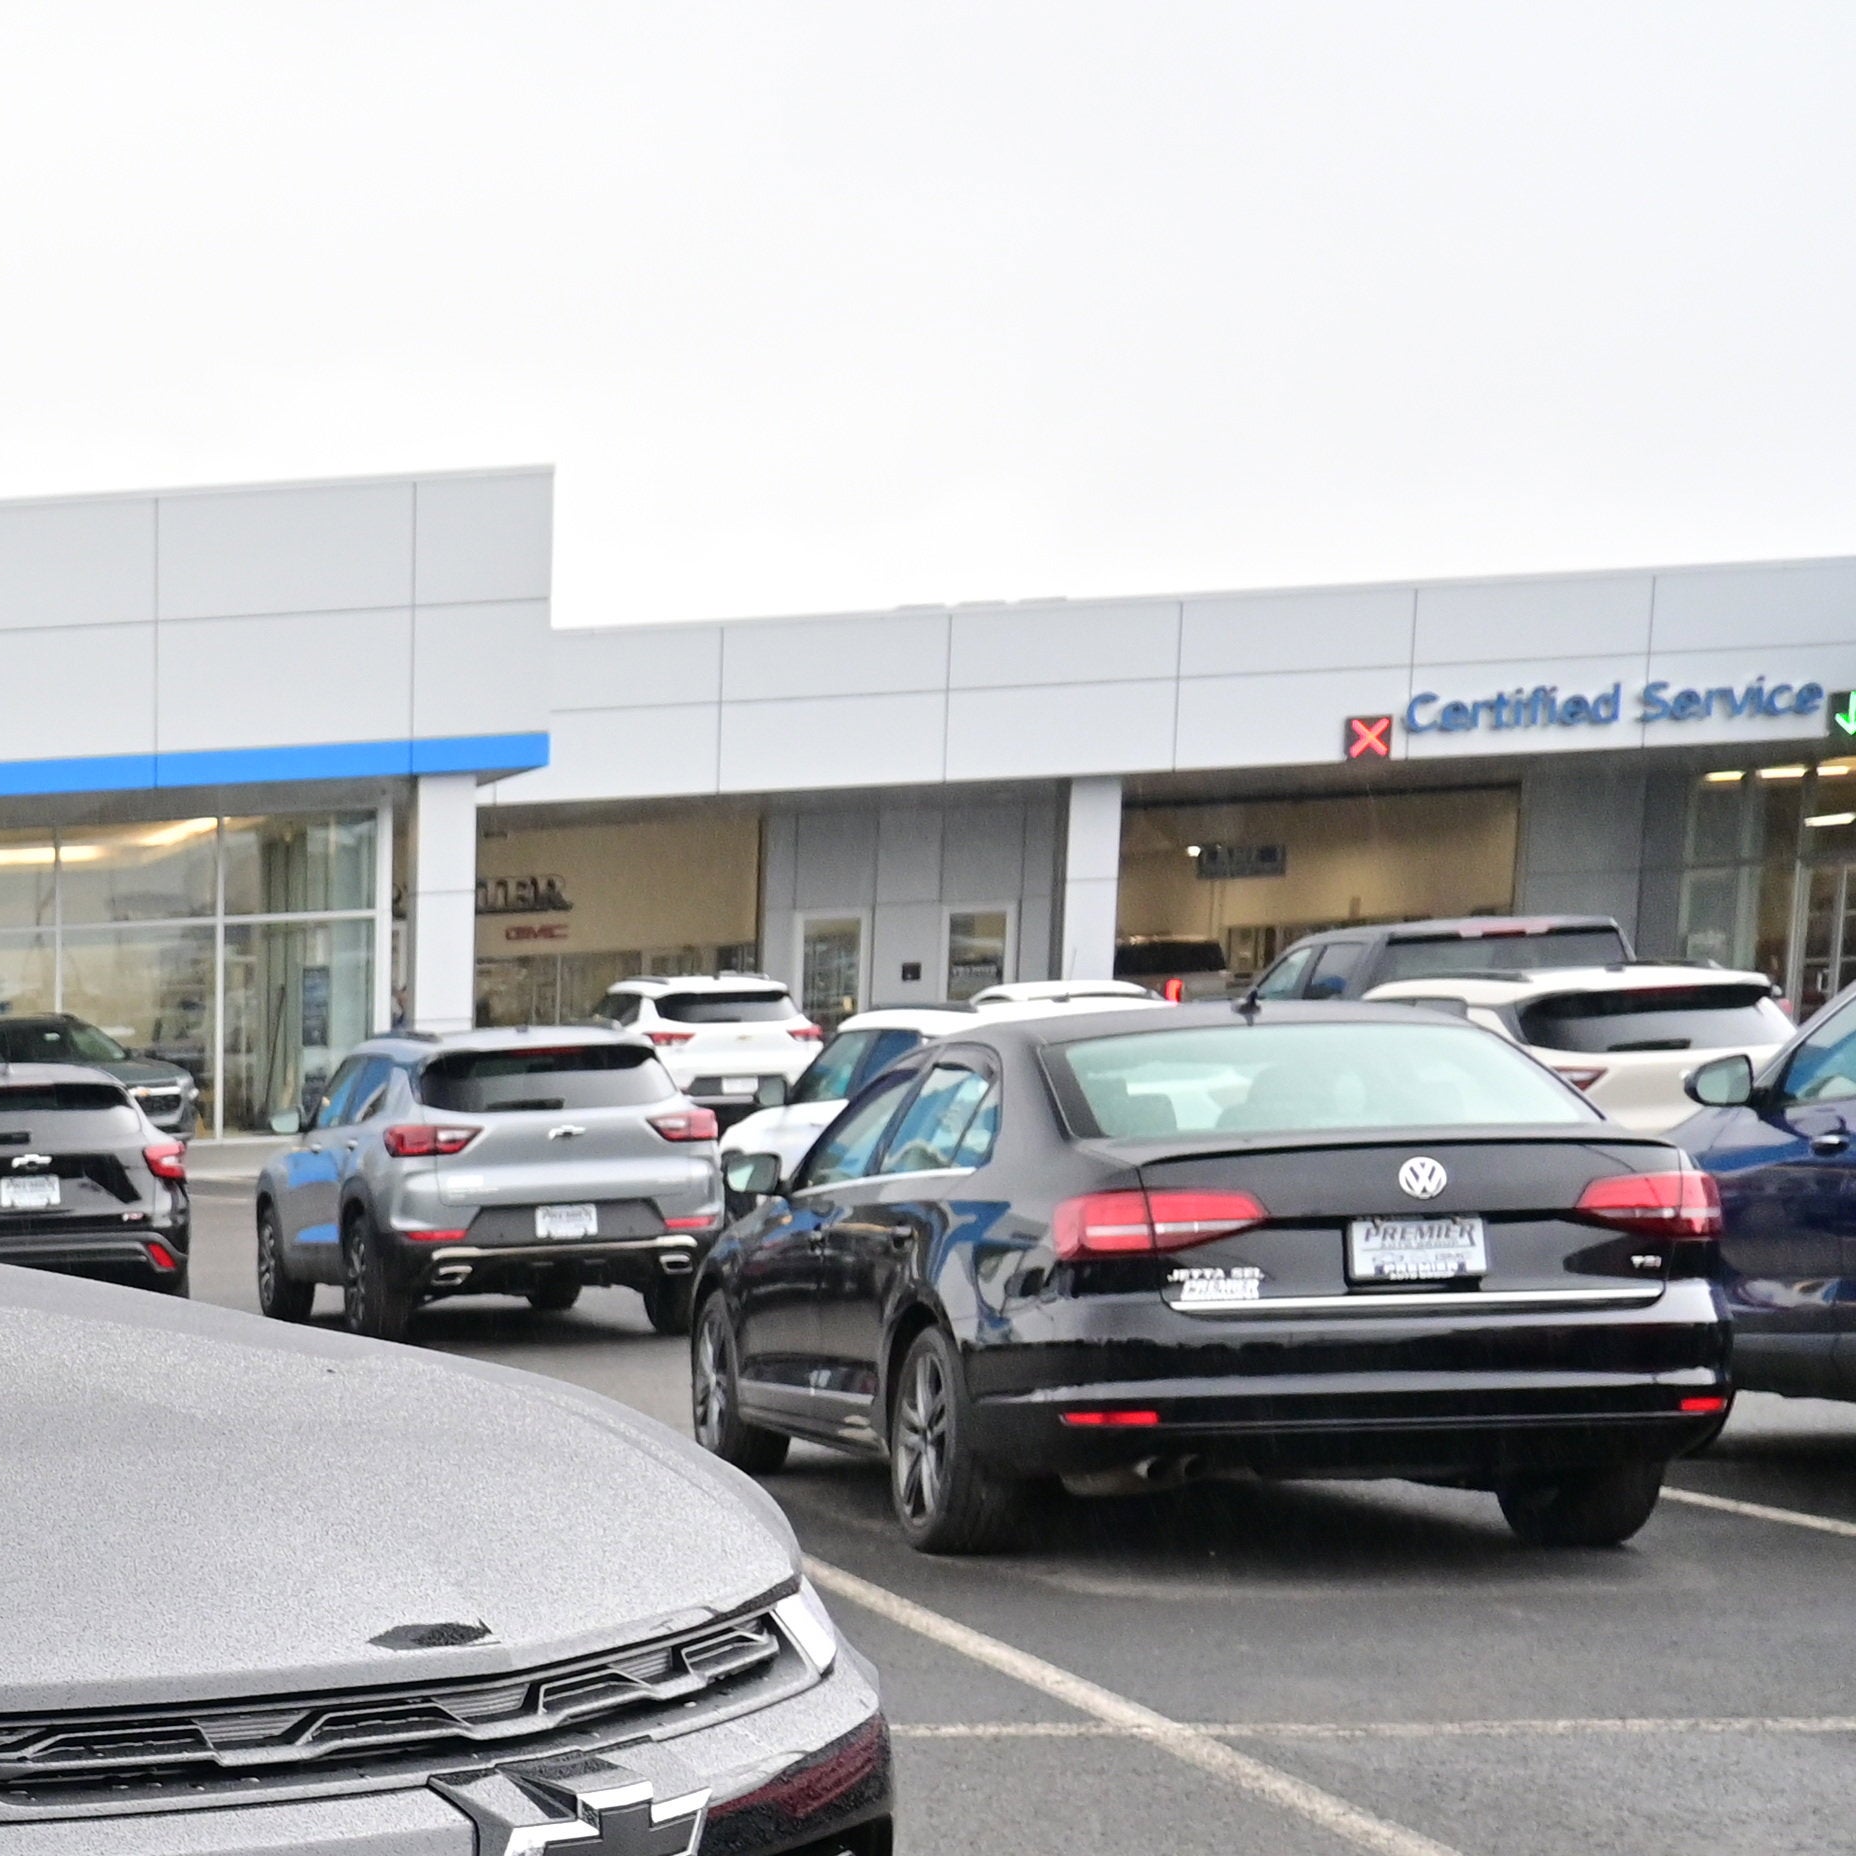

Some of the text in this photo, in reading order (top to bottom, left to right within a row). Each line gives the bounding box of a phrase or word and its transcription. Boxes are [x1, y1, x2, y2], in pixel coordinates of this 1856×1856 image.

[1404, 675, 1825, 733] Certified Service
[1364, 1222, 1476, 1247] PREMIER
